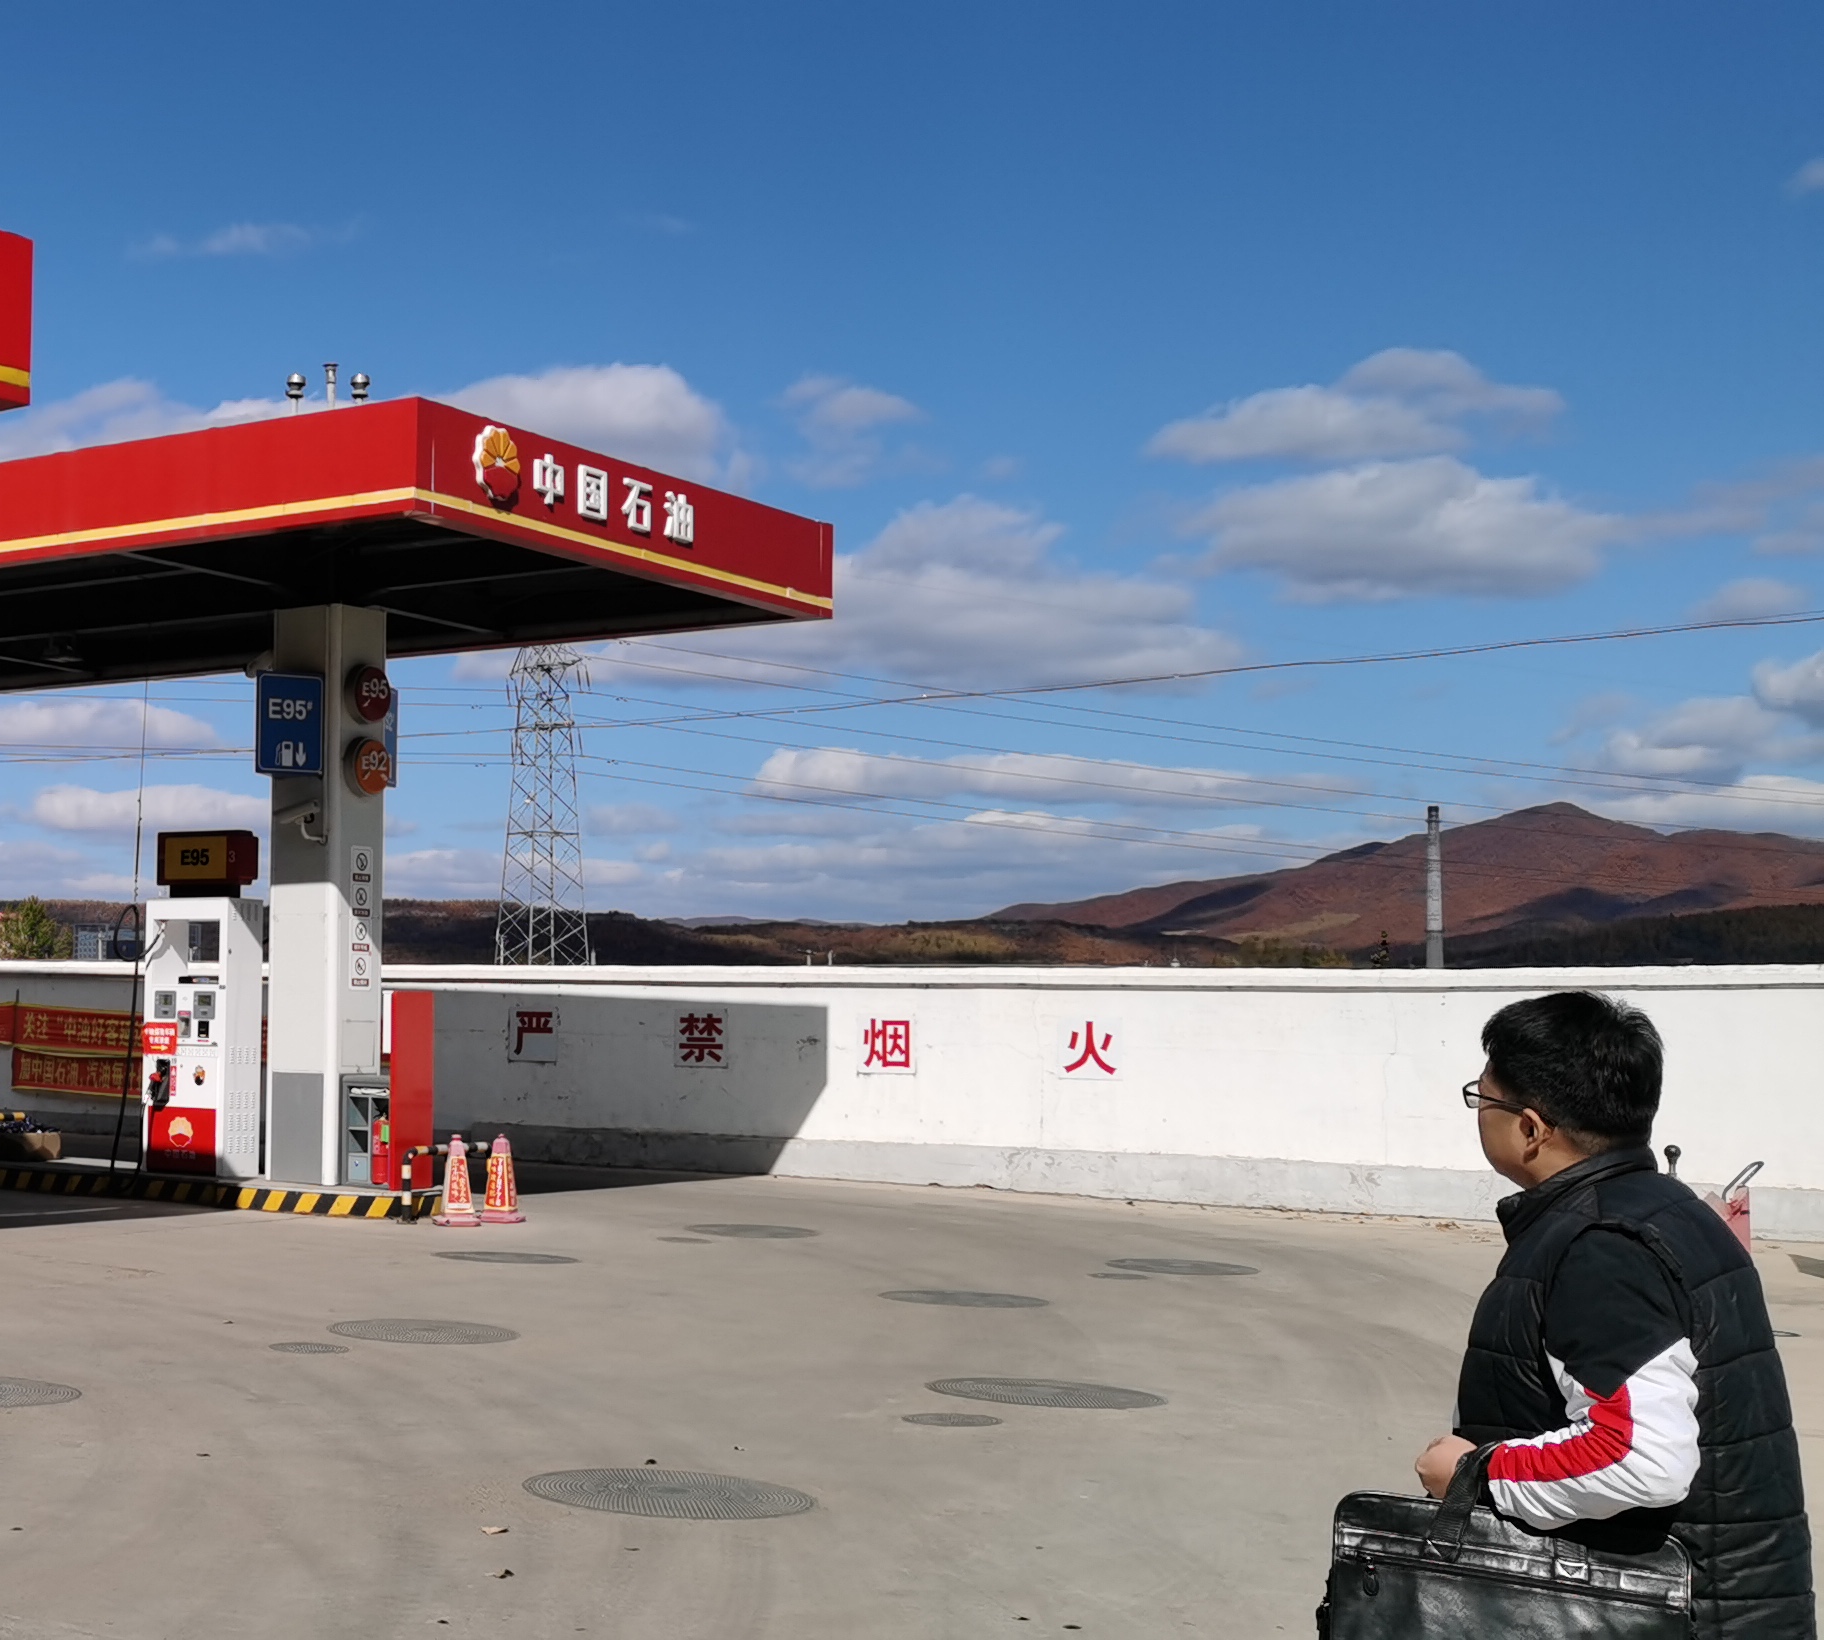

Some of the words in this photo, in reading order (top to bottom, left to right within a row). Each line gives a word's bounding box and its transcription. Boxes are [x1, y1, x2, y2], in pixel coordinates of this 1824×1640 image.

[533, 453, 694, 544] 中国石油
[362, 678, 387, 699] E95
[361, 750, 388, 771] E92
[180, 849, 210, 866] E95
[228, 851, 236, 863] 3
